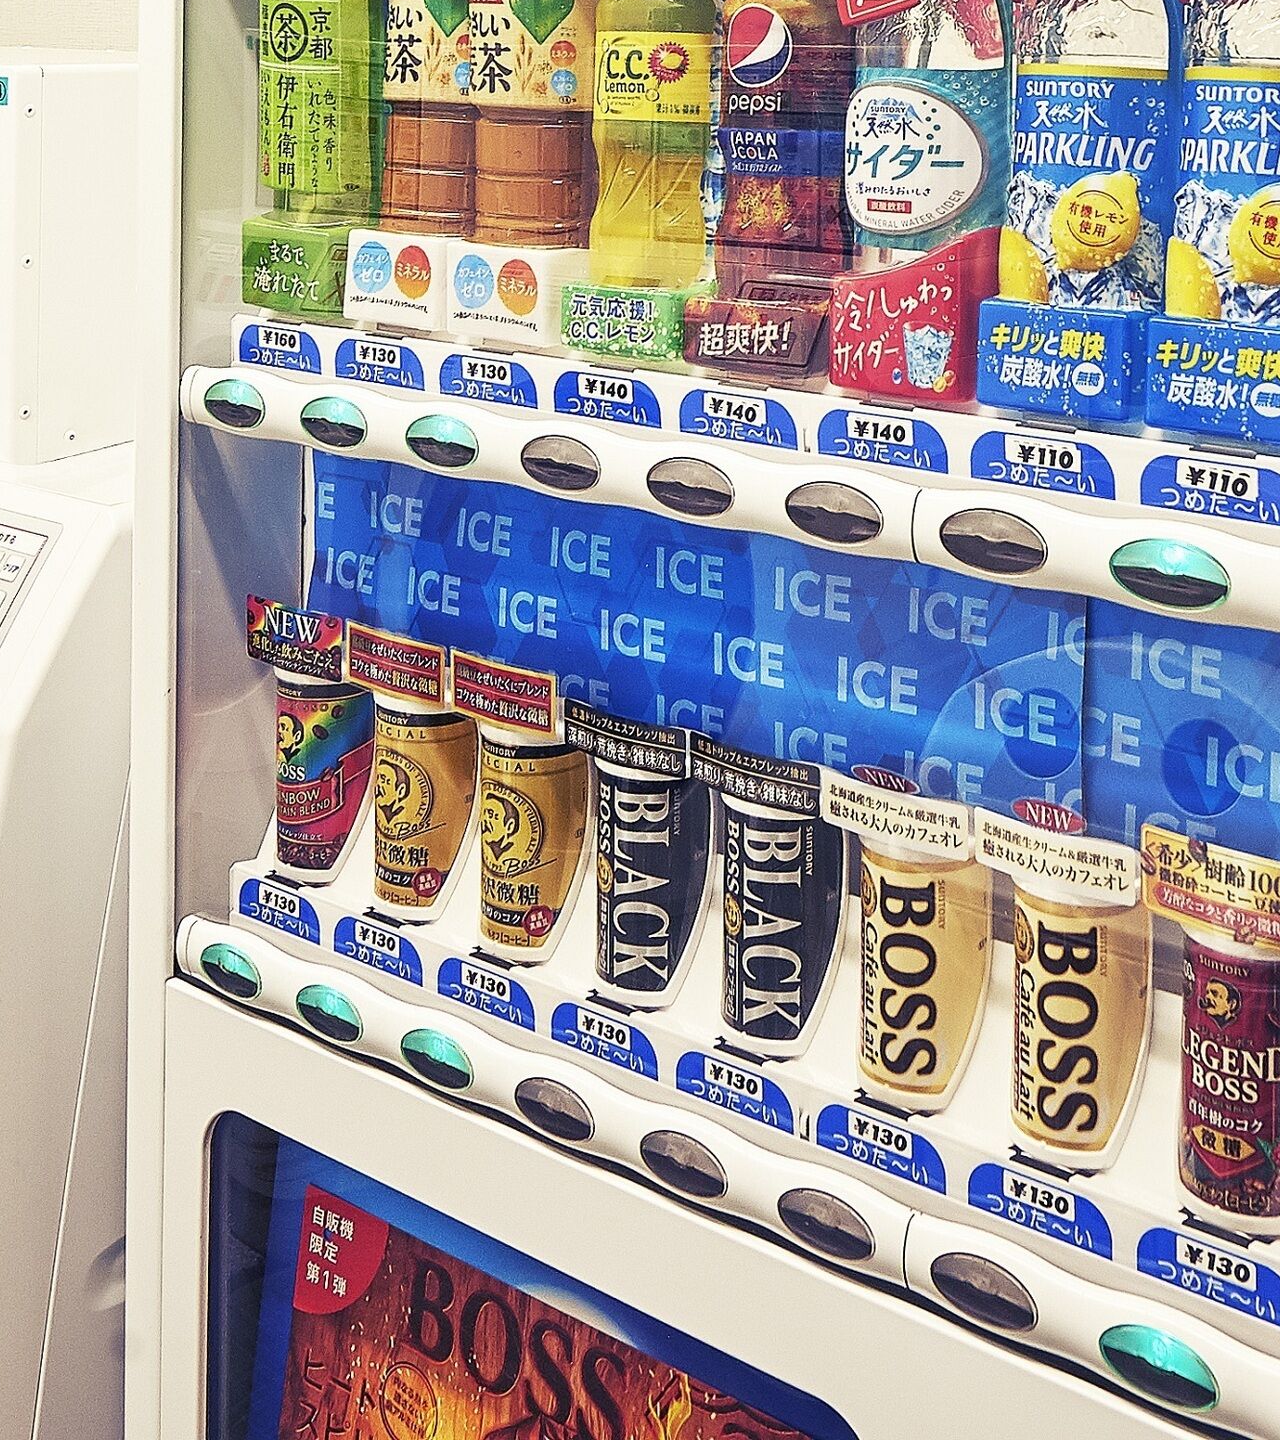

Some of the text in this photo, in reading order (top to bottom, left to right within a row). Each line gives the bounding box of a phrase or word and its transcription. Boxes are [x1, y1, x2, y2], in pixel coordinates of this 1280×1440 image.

[308, 6, 333, 61] 京都
[607, 49, 649, 79] C.C.
[729, 93, 782, 116] pepsi
[1026, 80, 1114, 100] SUNTORY
[277, 74, 298, 188] 伊右衛門
[863, 114, 920, 141] 天然水
[1031, 100, 1109, 129] 天然水
[738, 147, 778, 160] COLA
[847, 142, 964, 181] サイダー
[1067, 202, 1128, 225] 有機レモン
[1079, 220, 1107, 238] 使用
[397, 262, 430, 281] ミネラル
[499, 277, 537, 297] ミネラル
[262, 330, 297, 349] ¥160
[990, 322, 1105, 360] キリッと爽快
[467, 361, 508, 381] ¥130
[833, 339, 900, 374] サイダー
[1074, 367, 1102, 388] 無糖
[854, 420, 906, 442] ¥140
[370, 490, 423, 537] ICE
[656, 546, 724, 600] ICE
[774, 566, 851, 623] ICE
[263, 607, 321, 644] NEW
[498, 587, 557, 638] ICE
[837, 657, 919, 714] ICE
[863, 767, 906, 792] NEW
[1024, 801, 1073, 831] NEW
[612, 789, 670, 993] BLACK
[359, 927, 395, 950] ¥130
[743, 823, 801, 1030] BLACK
[879, 876, 937, 1076] BOSS
[1199, 954, 1250, 977] SUNTORY
[865, 920, 879, 1066] Café au Lait
[1037, 921, 1099, 1133] BOSS
[709, 1061, 759, 1094] ¥130
[1192, 1070, 1258, 1104] BOSS
[312, 1205, 355, 1242] 自販機
[309, 1232, 339, 1264] 限定
[1184, 1242, 1250, 1283] ¥130
[404, 1258, 626, 1440] BOSS
